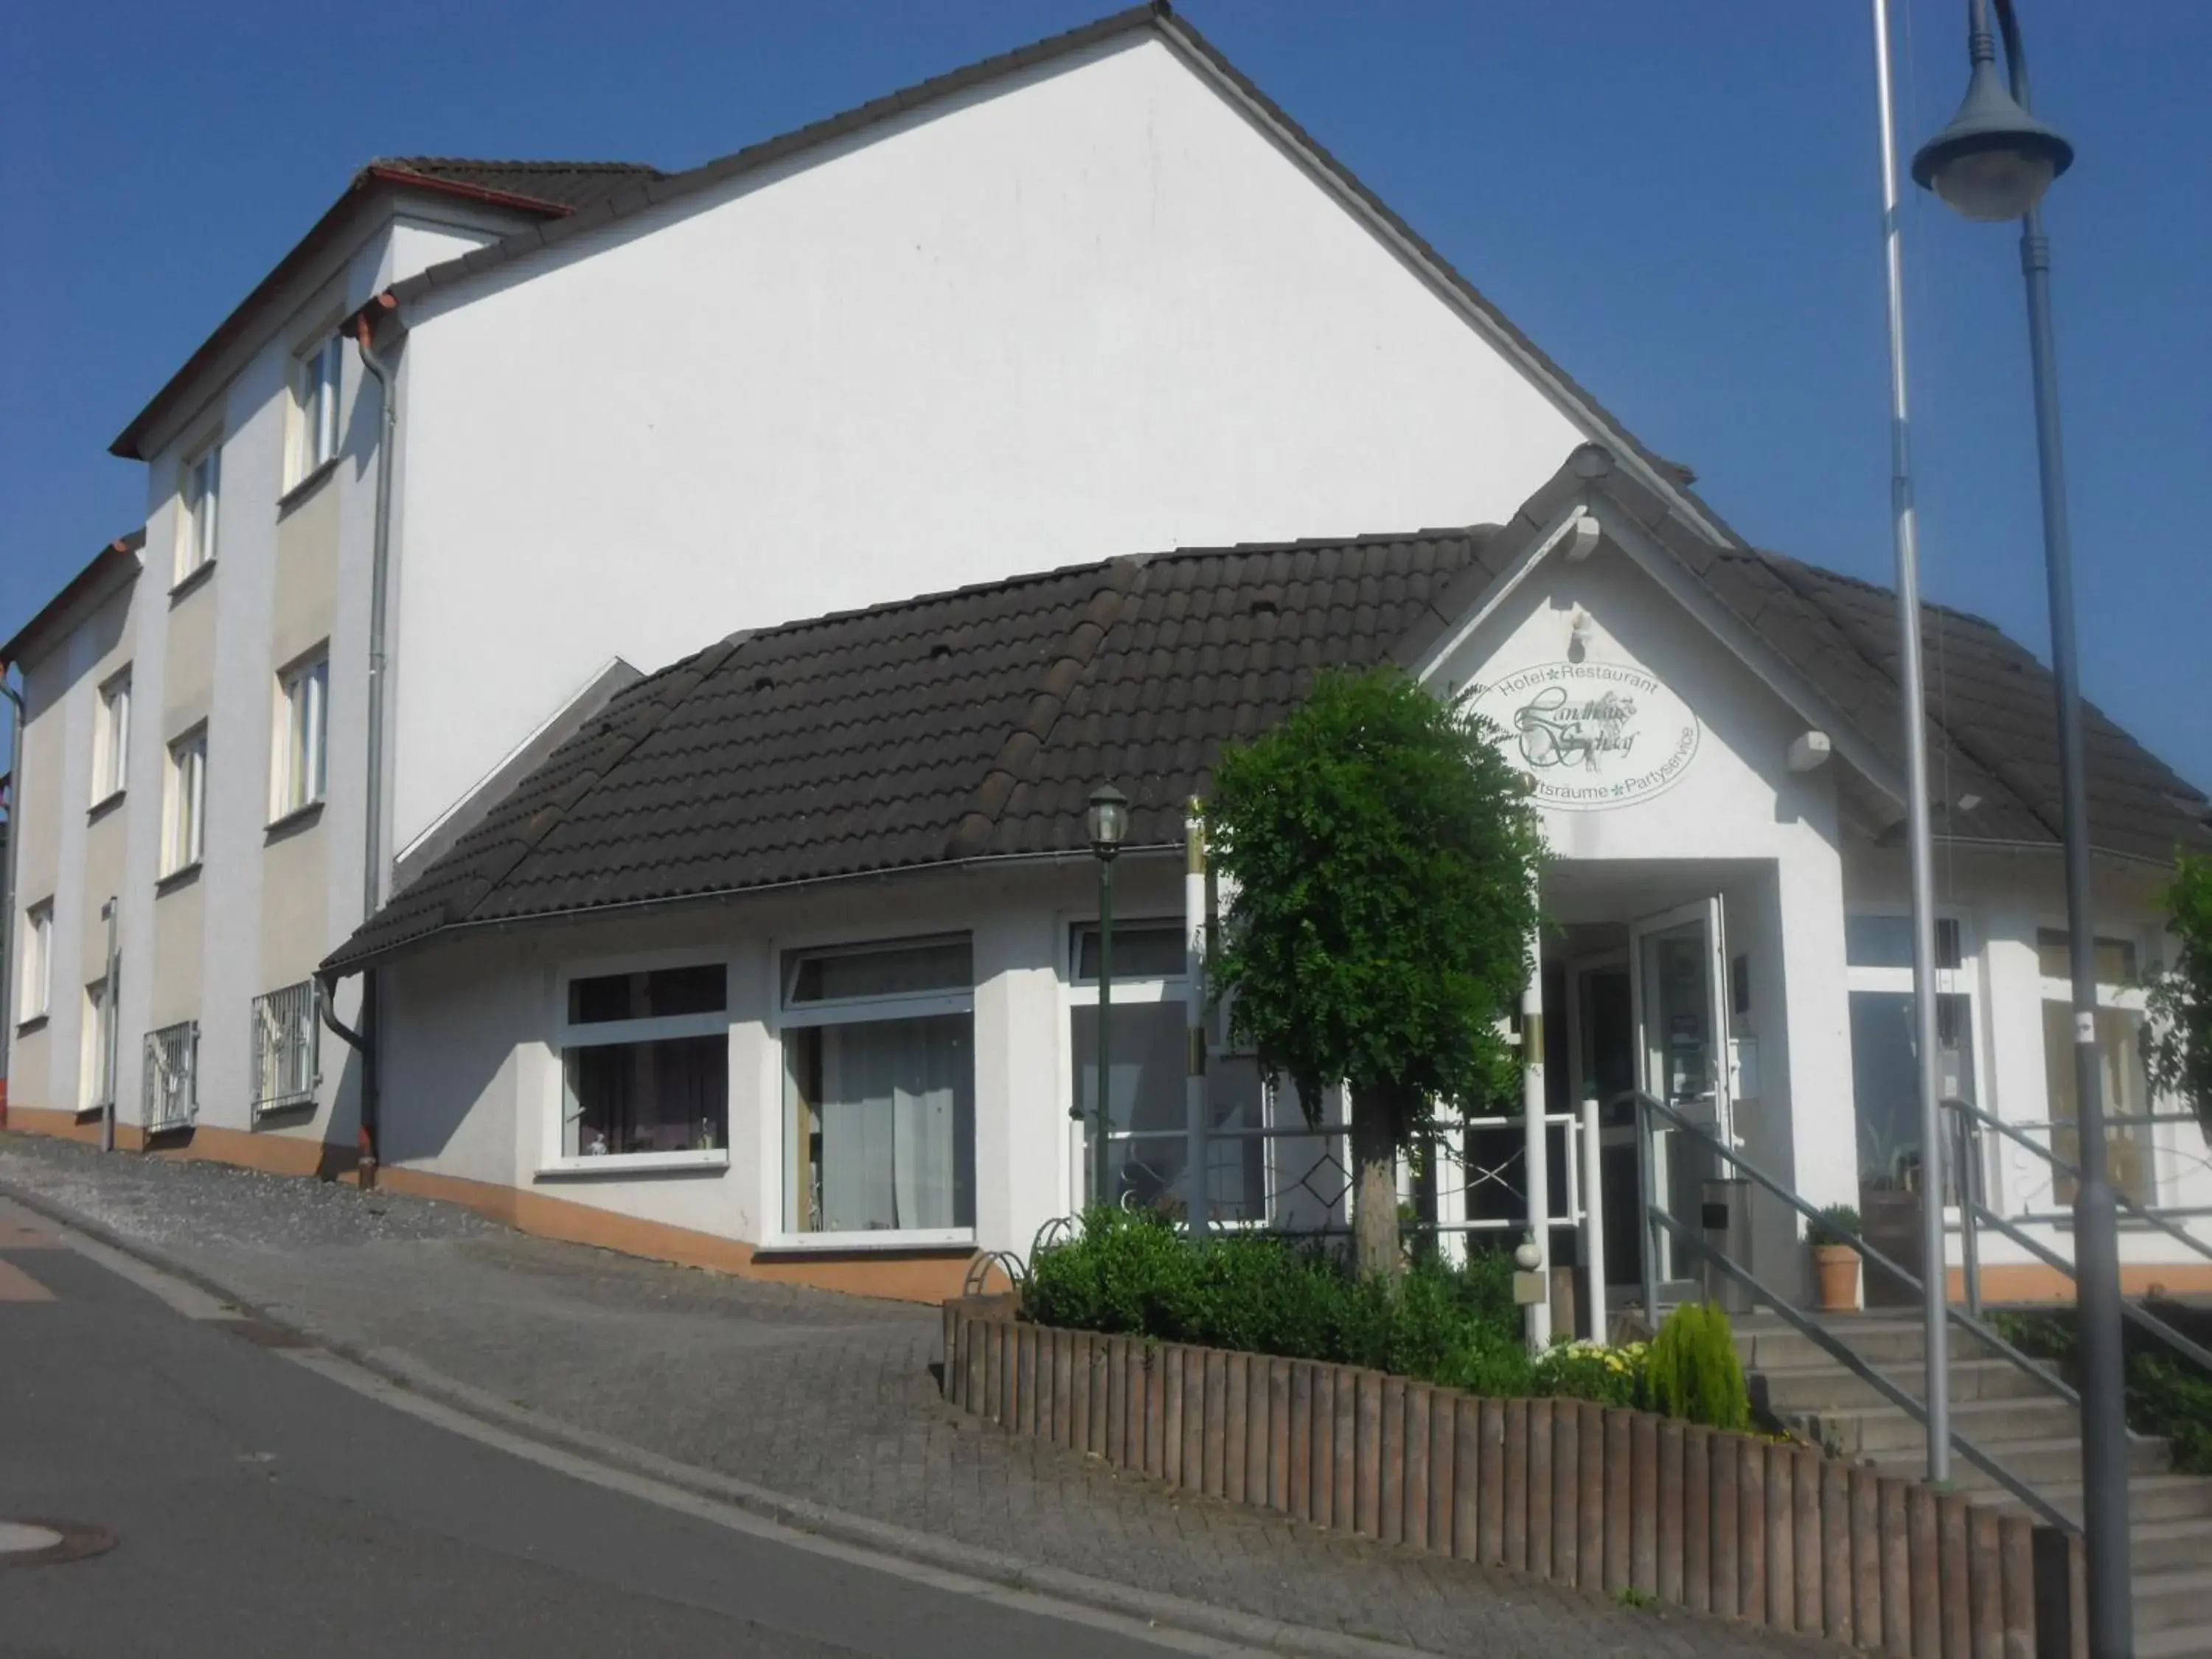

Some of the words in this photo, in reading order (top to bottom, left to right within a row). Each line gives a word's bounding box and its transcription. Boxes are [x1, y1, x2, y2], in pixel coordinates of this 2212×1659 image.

[1499, 669, 1545, 696] Hotel
[1562, 665, 1658, 694] Restaurant
[1624, 726, 1694, 792] Partyservice
